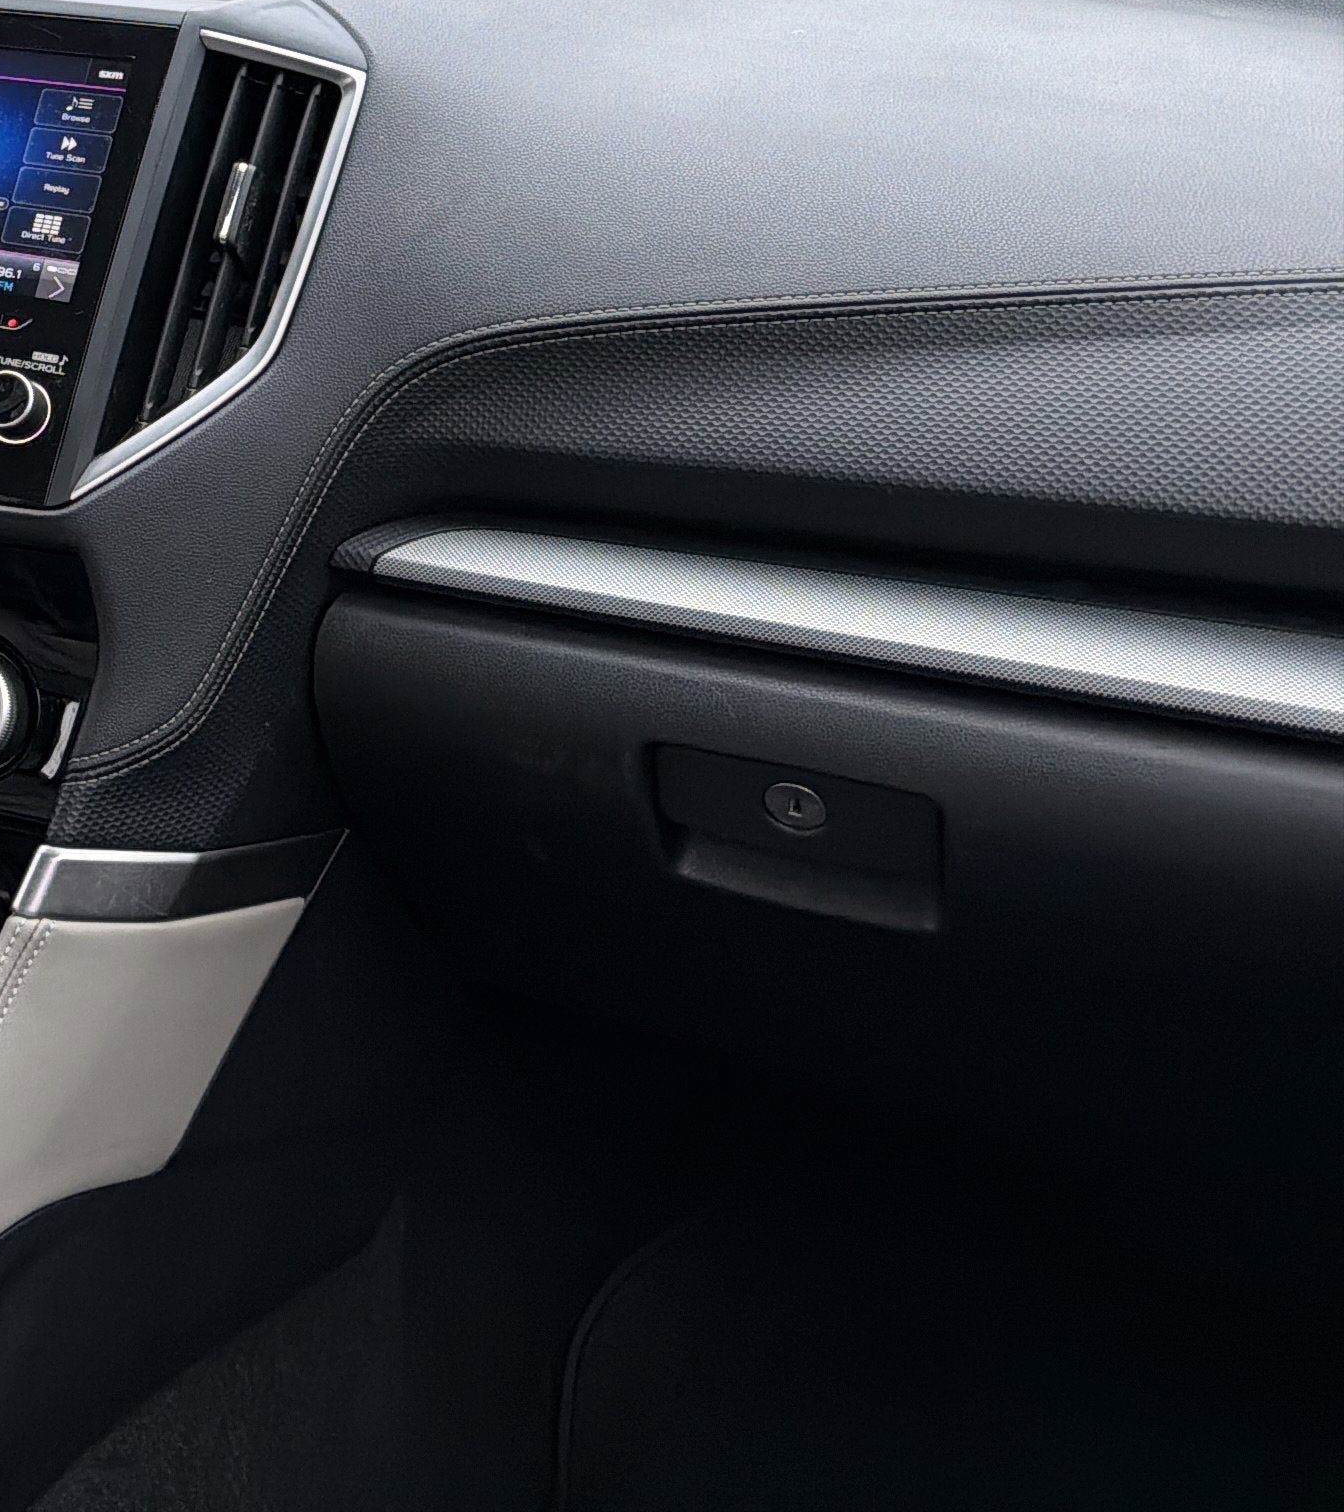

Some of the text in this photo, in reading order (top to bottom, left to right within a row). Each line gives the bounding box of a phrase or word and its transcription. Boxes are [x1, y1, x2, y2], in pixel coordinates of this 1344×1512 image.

[98, 69, 124, 80] sxm
[61, 112, 91, 124] Browse
[21, 230, 45, 242] Direct
